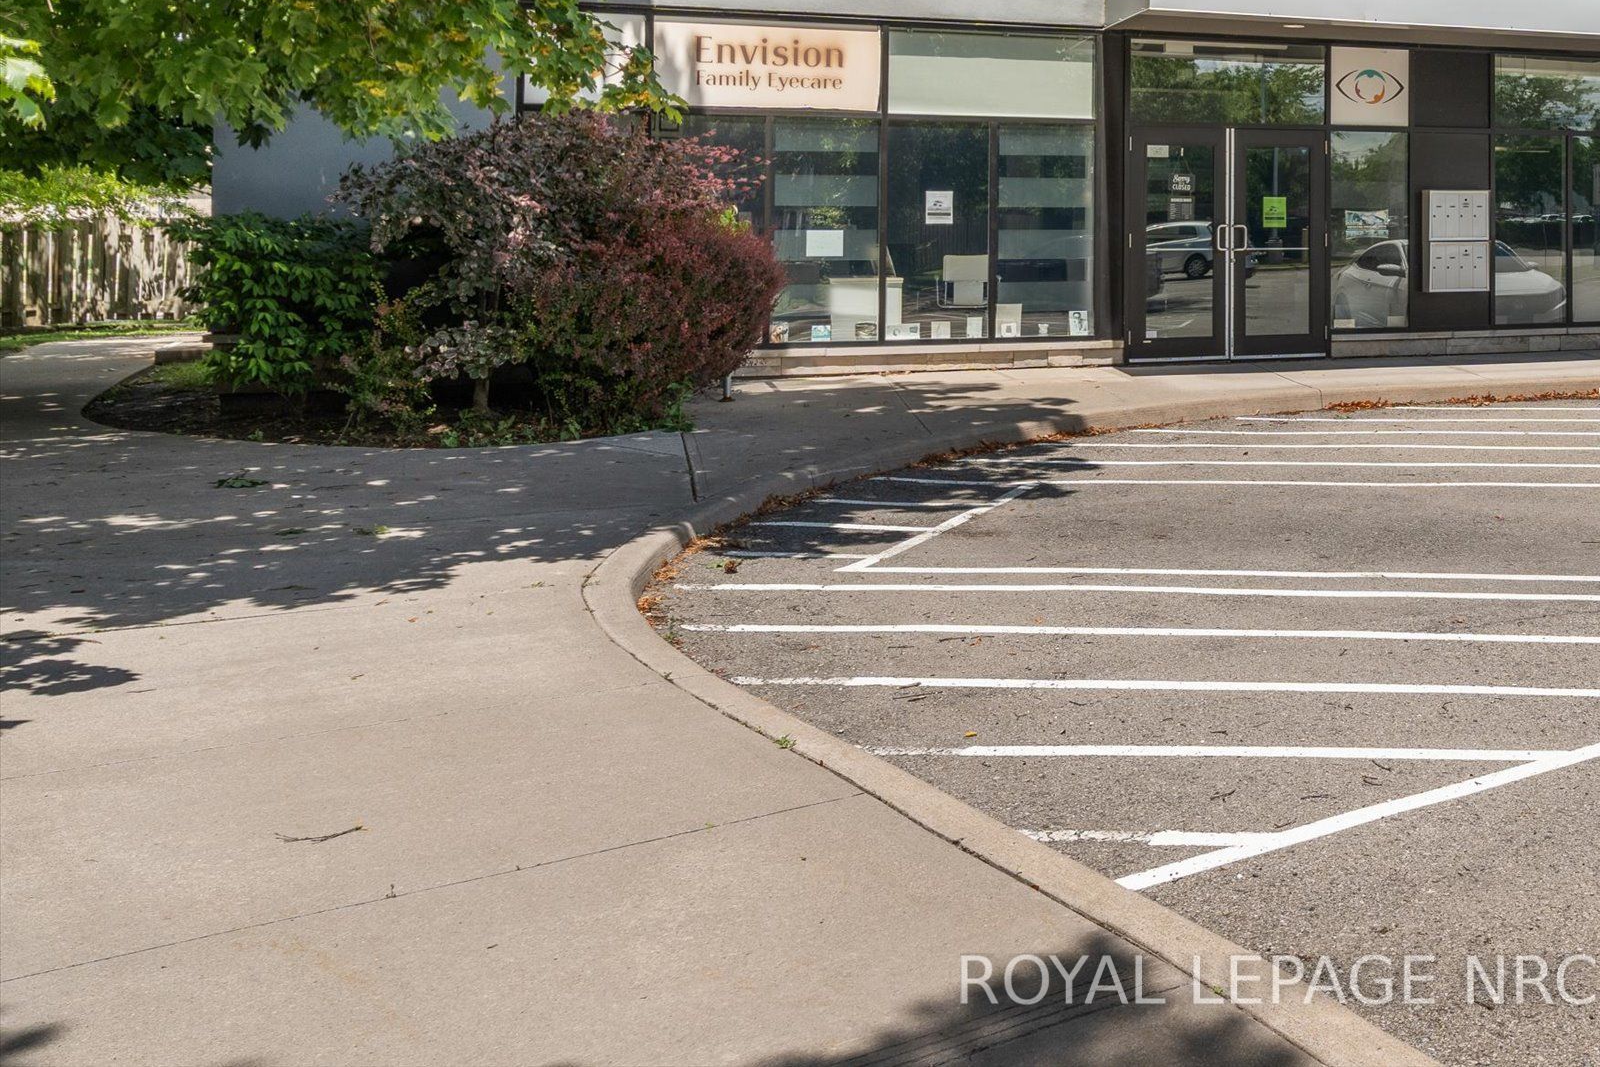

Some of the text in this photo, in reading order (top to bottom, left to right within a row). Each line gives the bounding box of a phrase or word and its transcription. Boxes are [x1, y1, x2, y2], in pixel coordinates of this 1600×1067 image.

[695, 35, 844, 68] Envision
[696, 69, 843, 91] Family Eyecare
[1172, 183, 1191, 191] CLOSED
